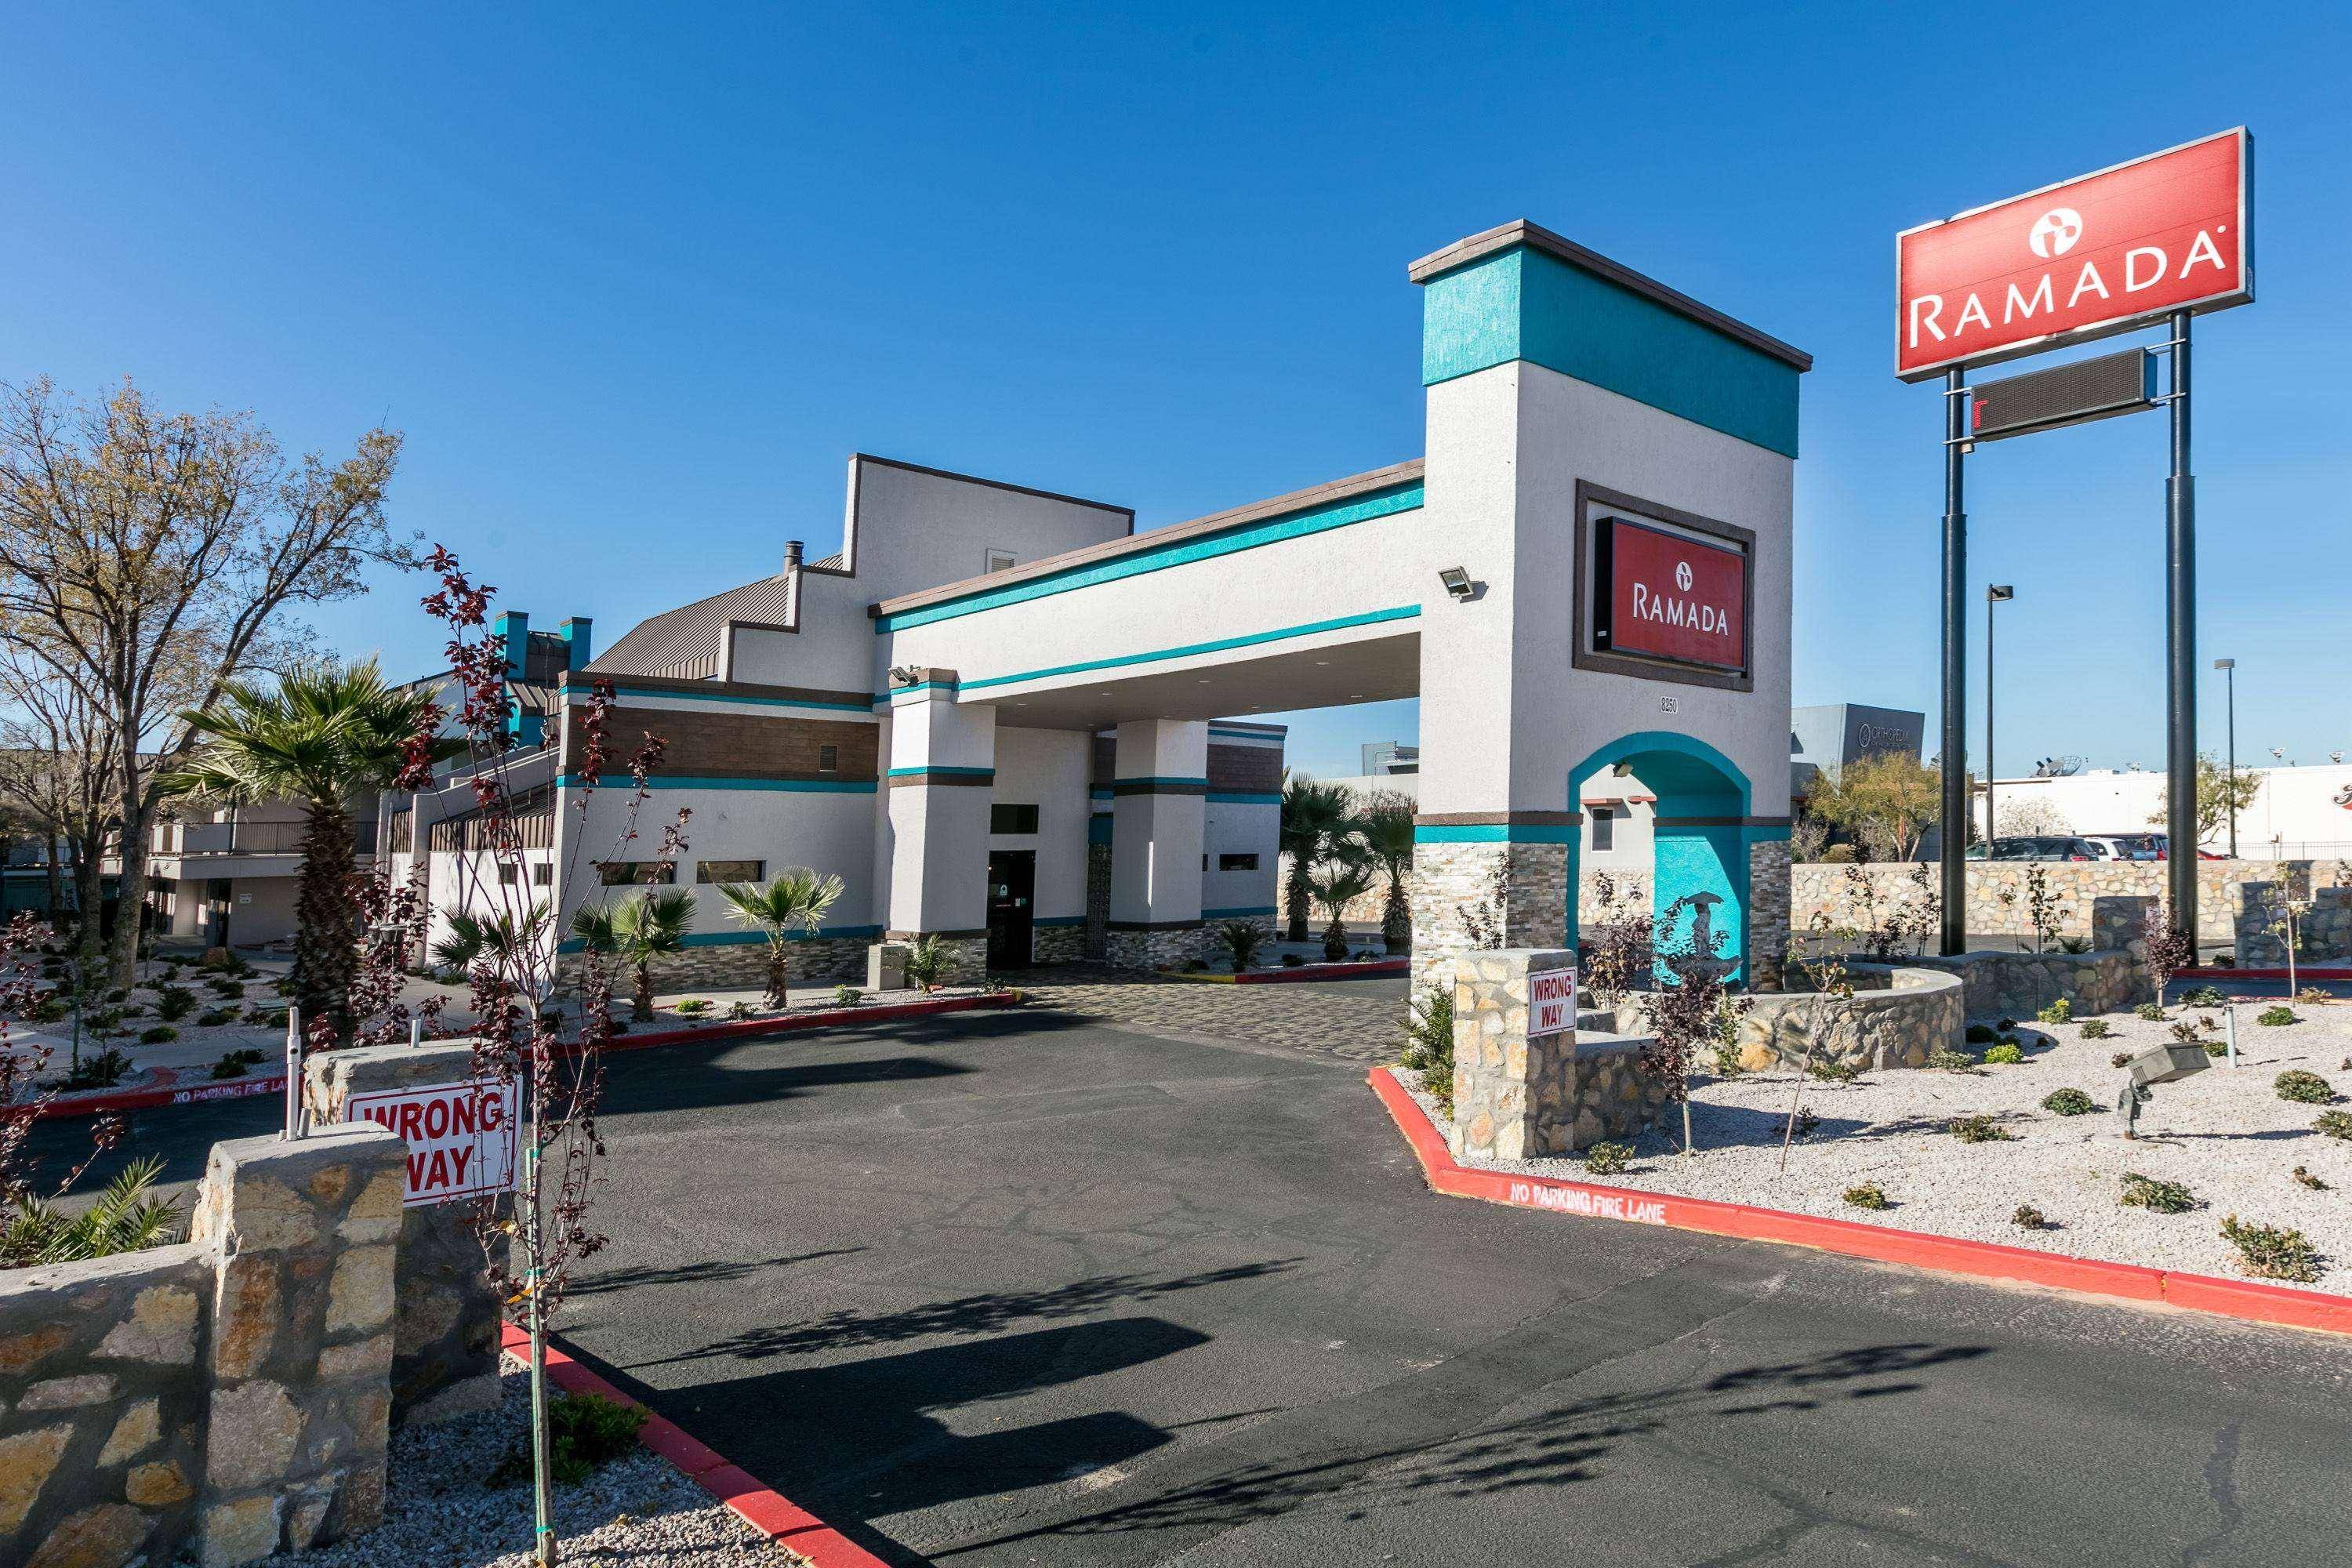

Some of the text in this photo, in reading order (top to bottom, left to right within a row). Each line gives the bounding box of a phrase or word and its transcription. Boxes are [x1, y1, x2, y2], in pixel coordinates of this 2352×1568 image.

[1909, 230, 2226, 349] RAMADA
[1632, 582, 1729, 636] RAMADA
[1661, 697, 1677, 713] 8250
[1534, 975, 1571, 1002] WRONG
[1541, 1004, 1563, 1028] WAY
[173, 1080, 288, 1103] NO PARKING FIRE LA
[1510, 1182, 1666, 1225] NO PARKING FIRE LANE
